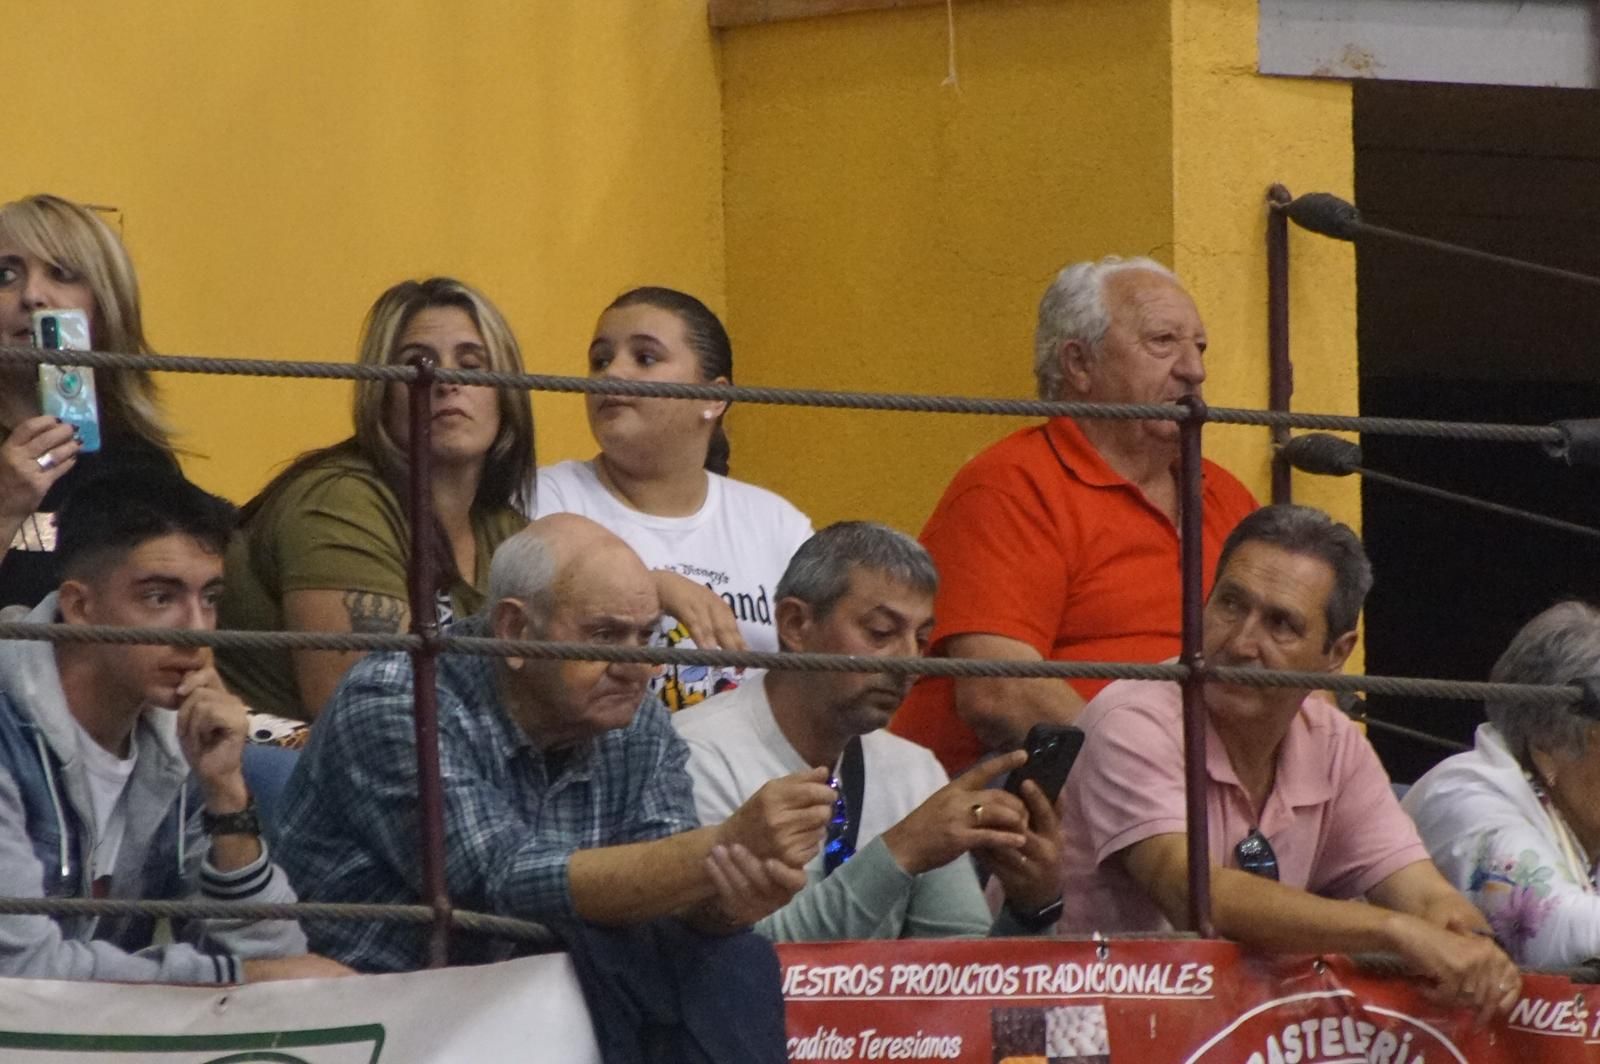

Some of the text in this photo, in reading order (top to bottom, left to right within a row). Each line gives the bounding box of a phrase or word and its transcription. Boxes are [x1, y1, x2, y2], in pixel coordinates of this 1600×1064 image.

[706, 582, 772, 625] and
[890, 962, 1020, 995] PRODUCTOS
[1023, 962, 1214, 995] TRADICIONALES
[858, 1028, 963, 1060] Teresianos
